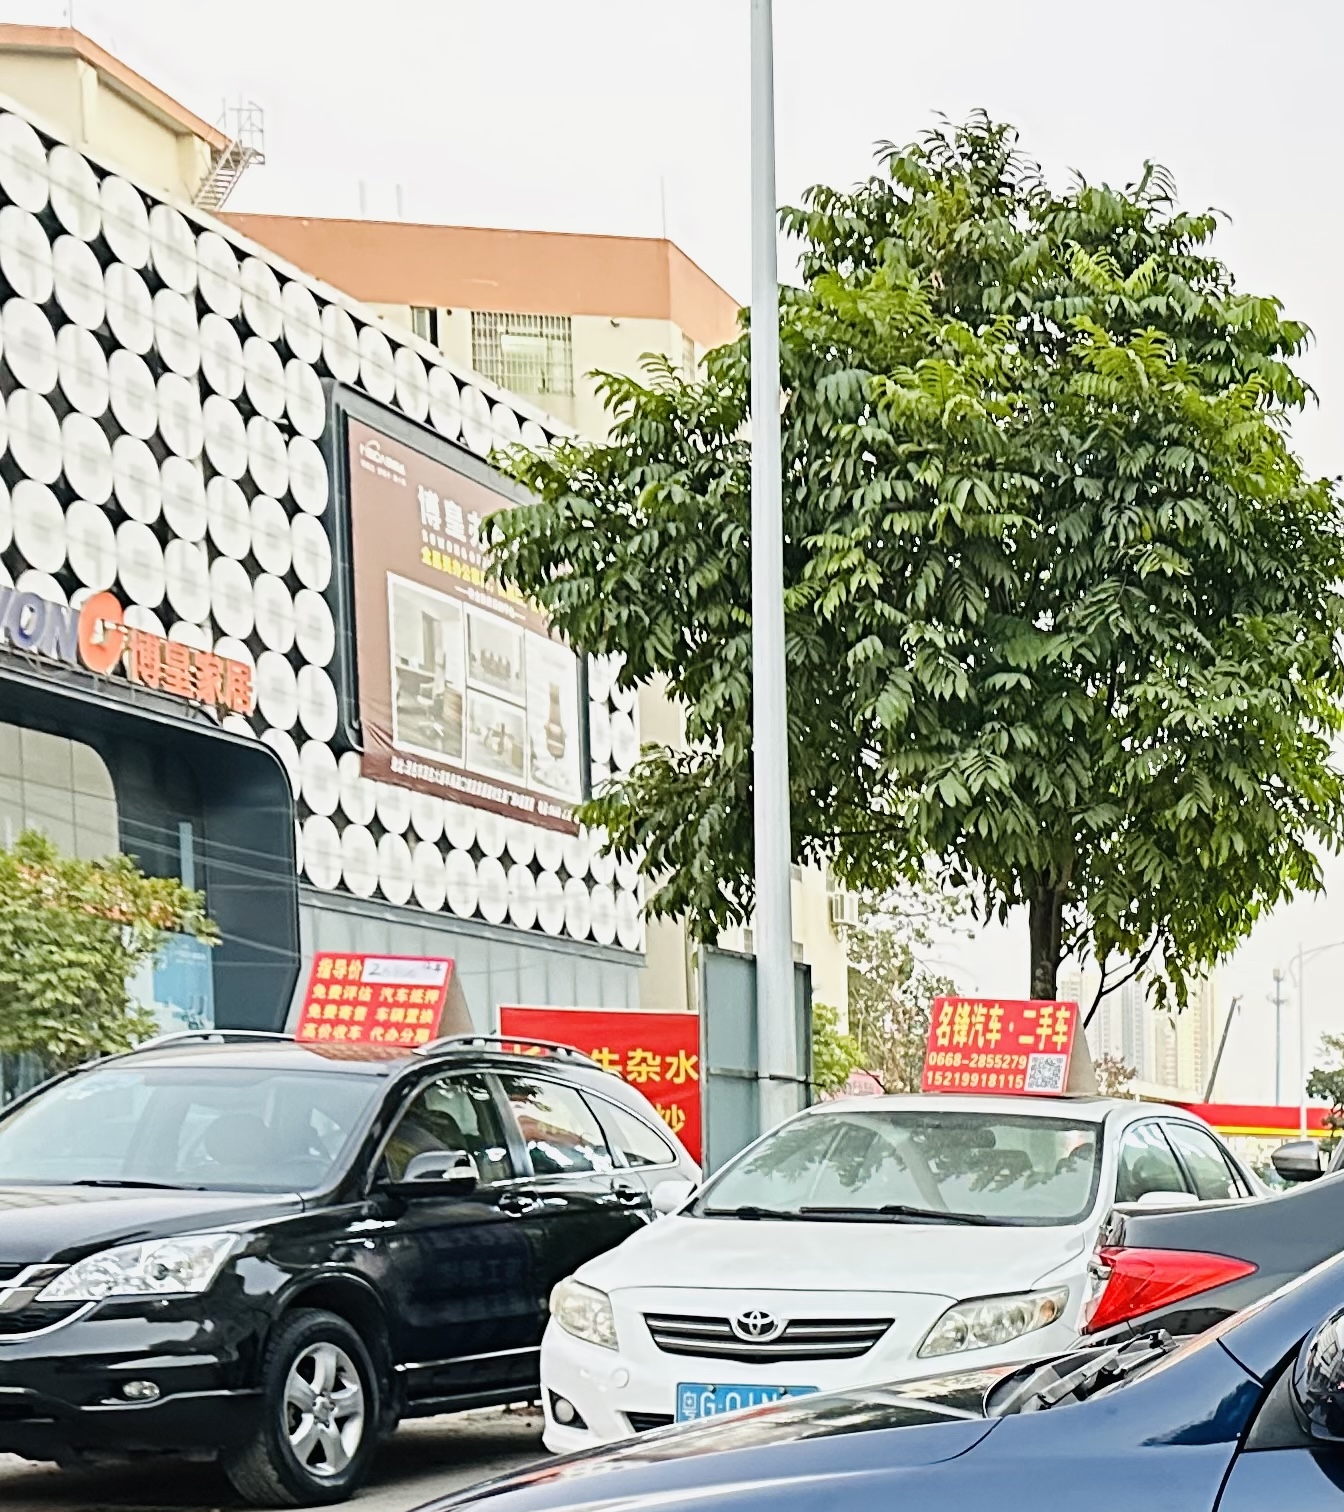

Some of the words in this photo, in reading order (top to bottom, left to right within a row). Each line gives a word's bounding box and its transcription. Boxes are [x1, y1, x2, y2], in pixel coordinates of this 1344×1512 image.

[0, 586, 124, 675] ONG
[129, 628, 253, 717] 博皇家居
[316, 957, 363, 980] 指导价
[928, 1052, 1027, 1070] 0668-2855279
[926, 1071, 1024, 1089] 15219918115
